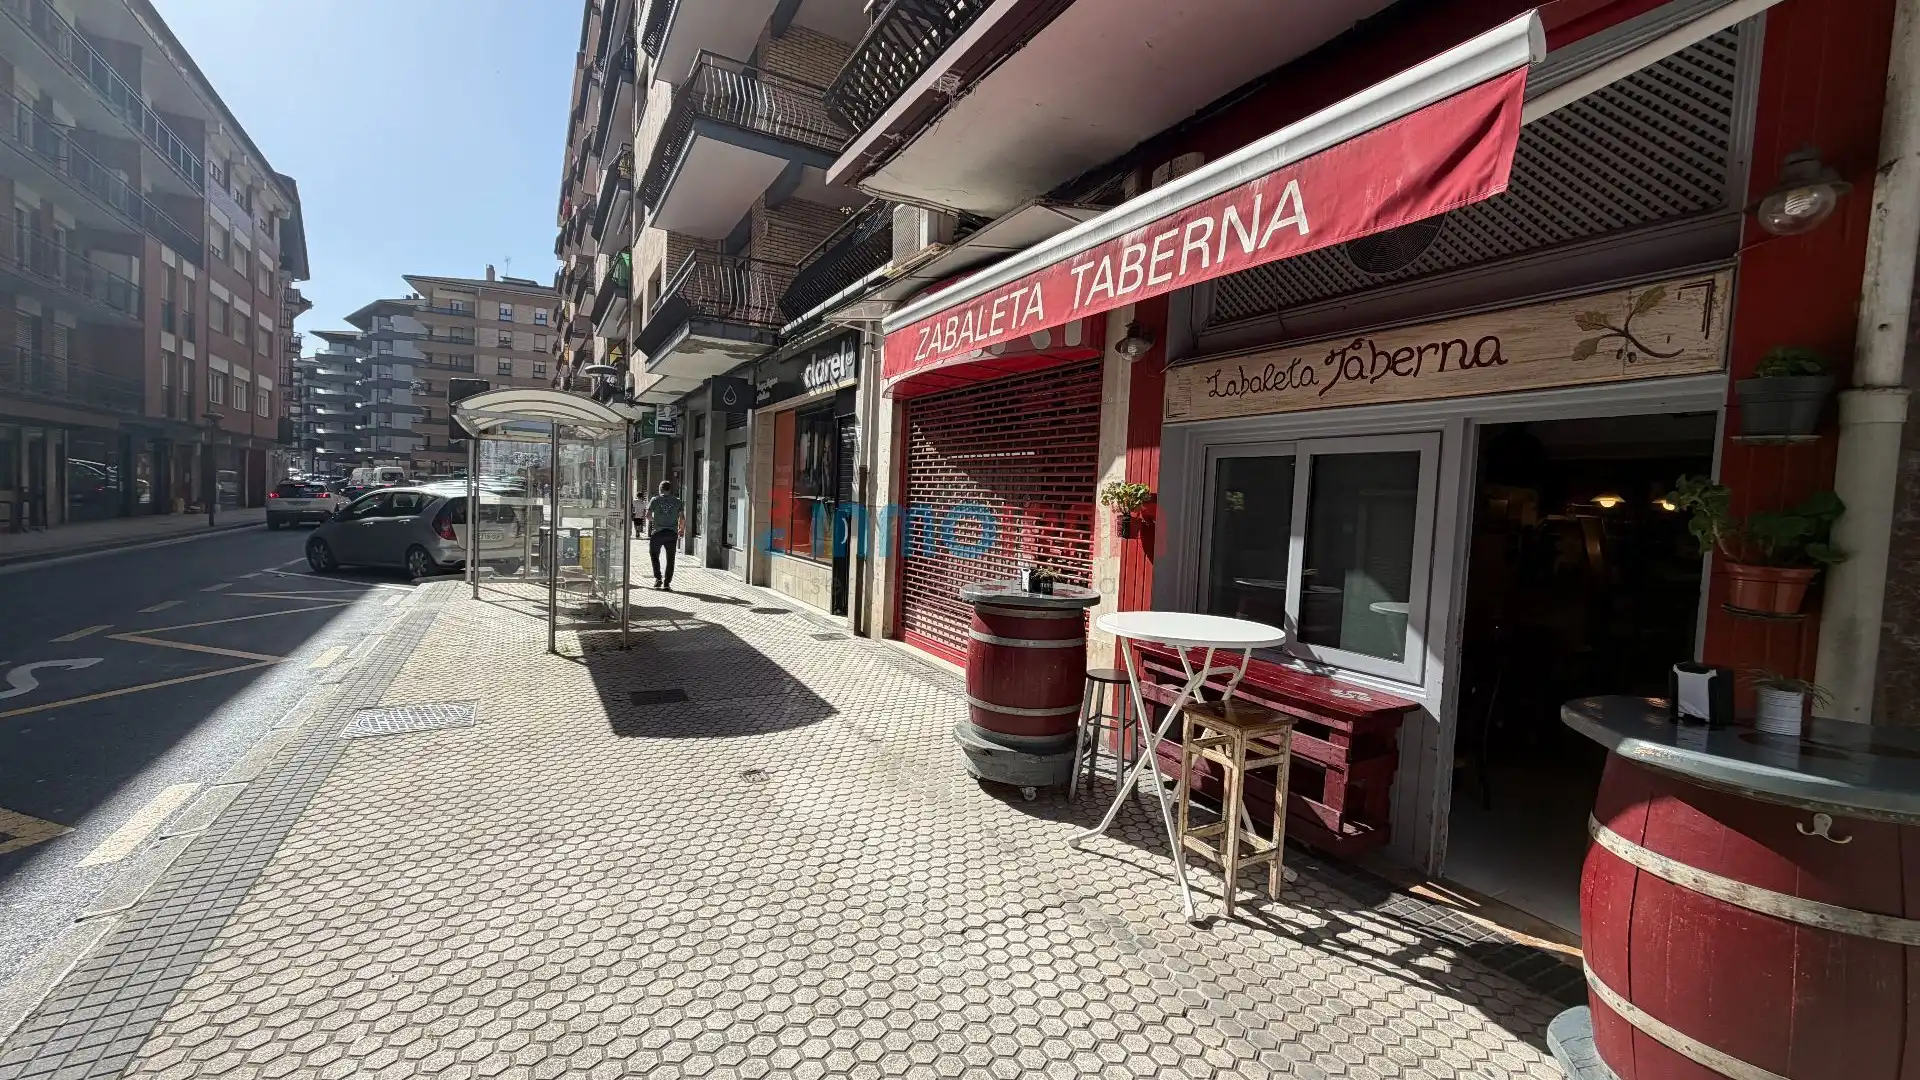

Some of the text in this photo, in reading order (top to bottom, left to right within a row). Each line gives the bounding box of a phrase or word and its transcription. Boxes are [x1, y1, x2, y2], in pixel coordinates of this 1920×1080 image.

[914, 179, 1310, 362] ZABALETA TABERNA
[803, 340, 846, 389] clarel
[1318, 335, 1509, 397] Taberna
